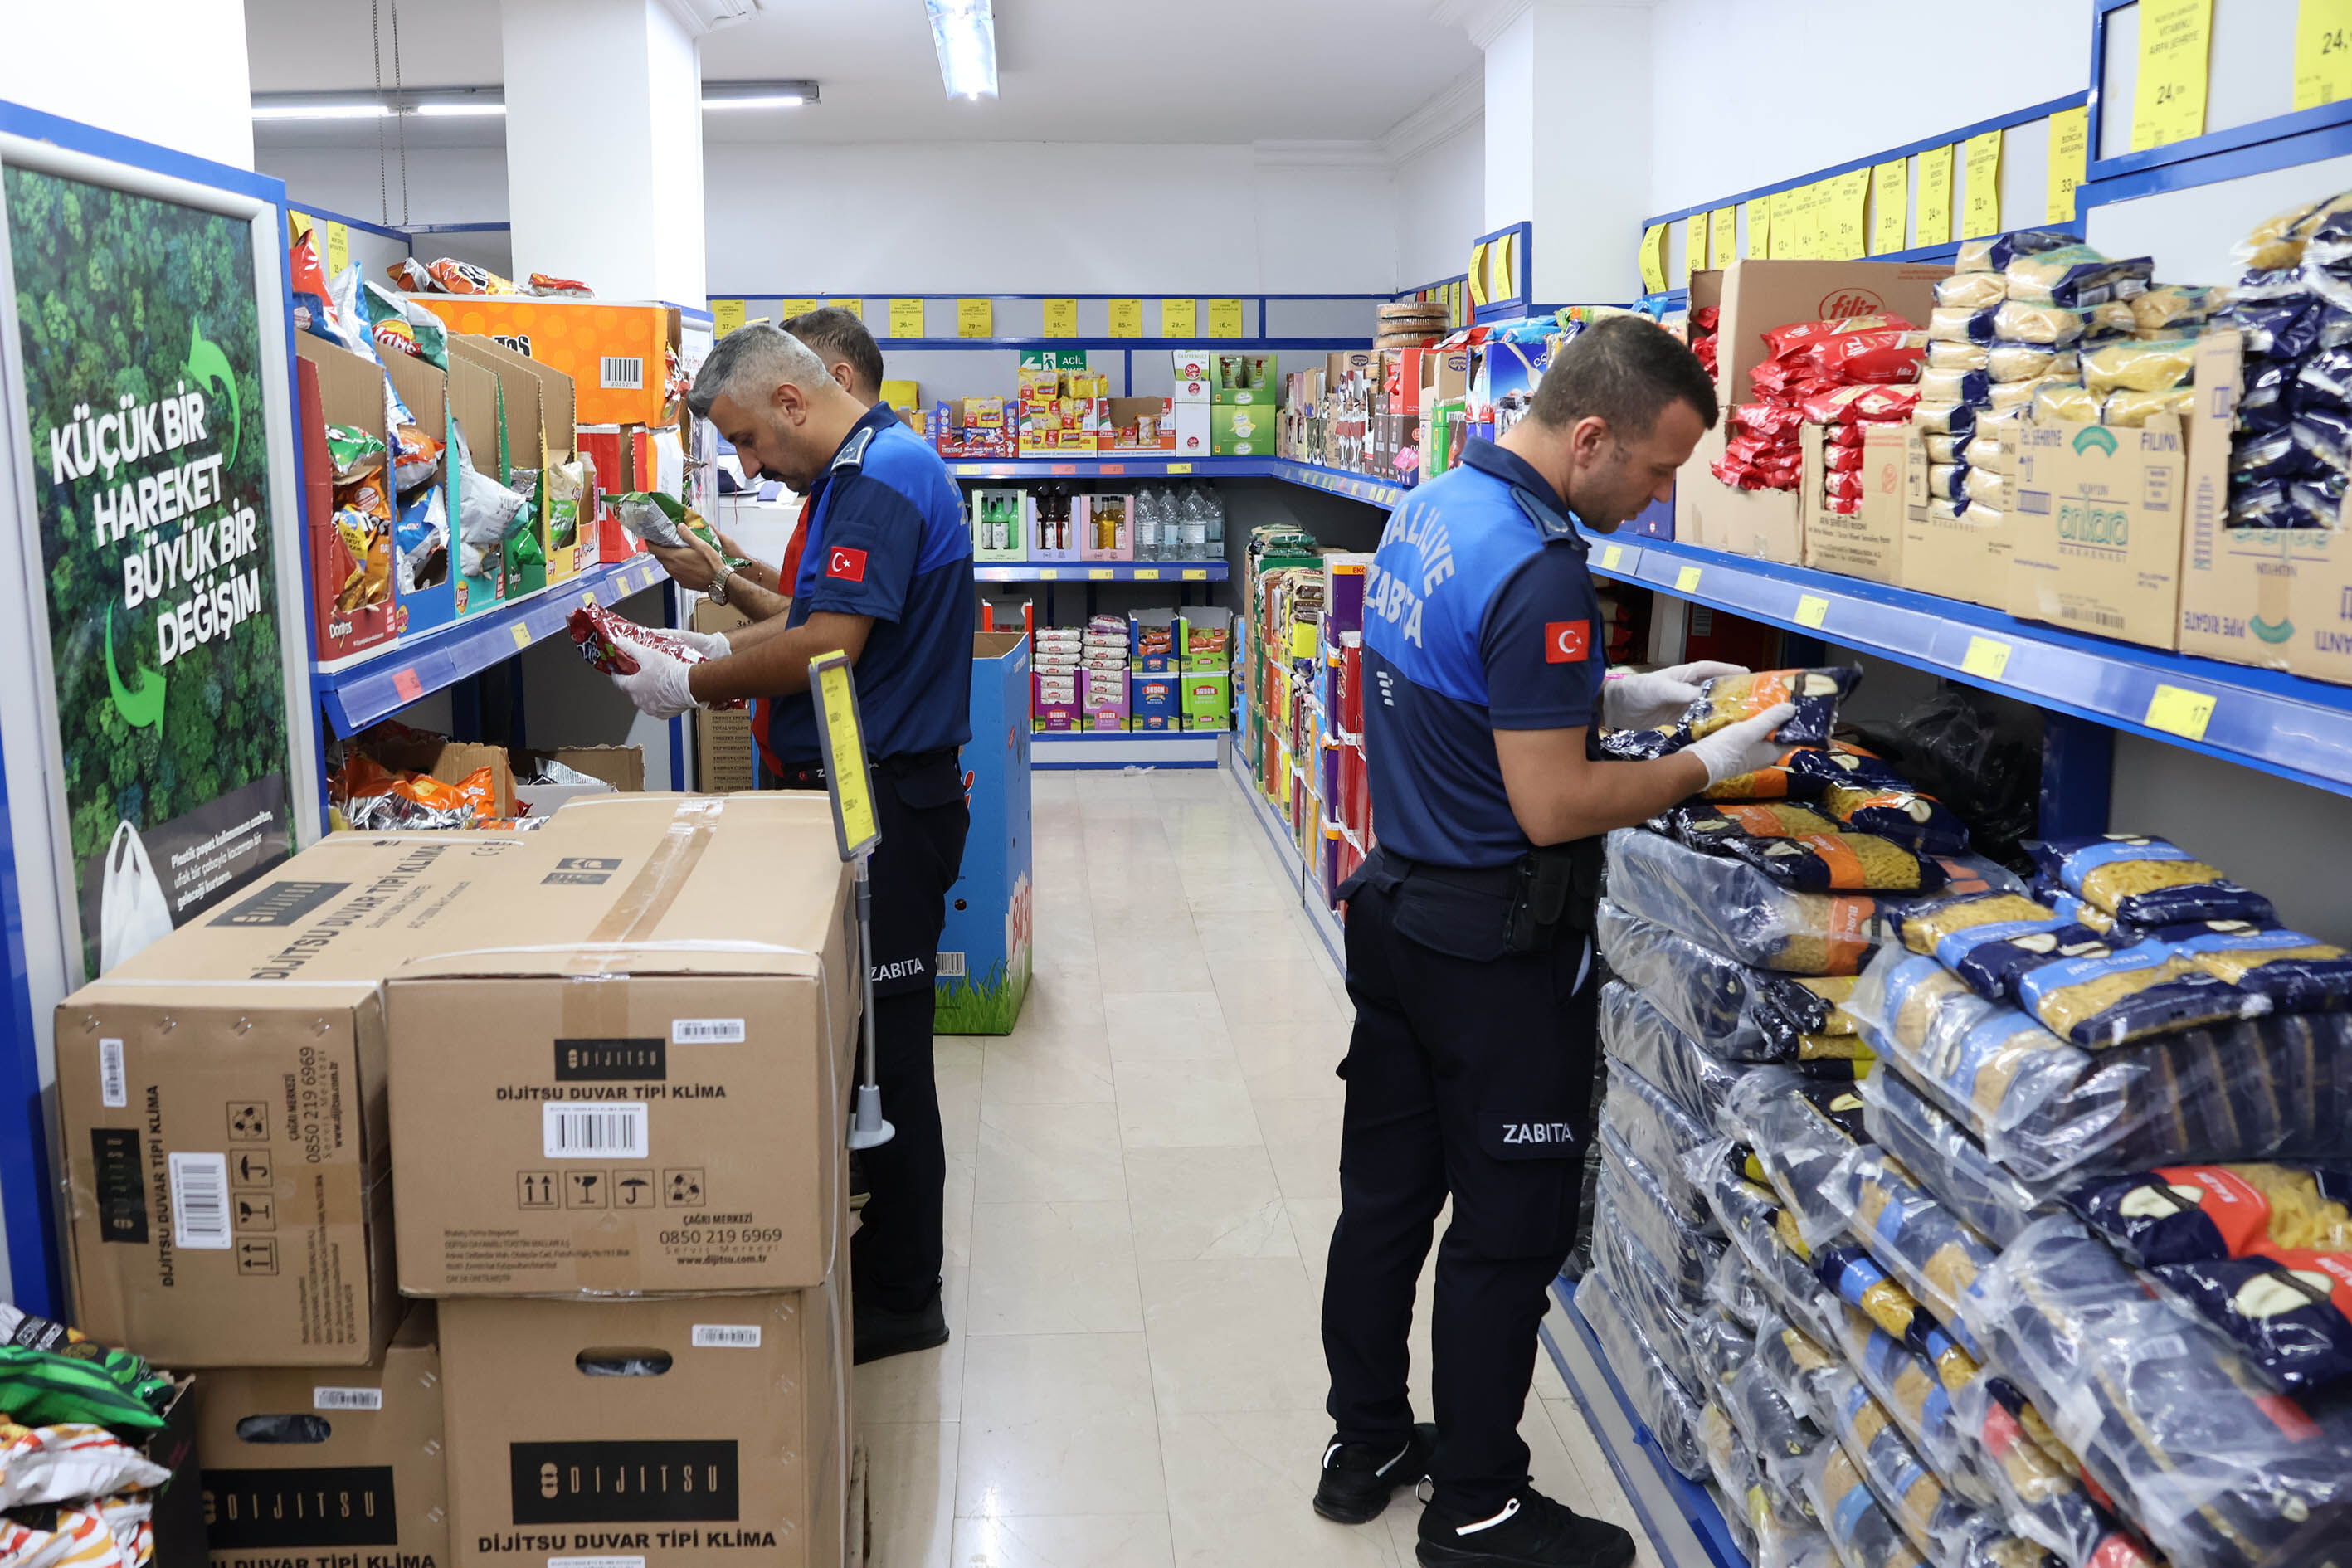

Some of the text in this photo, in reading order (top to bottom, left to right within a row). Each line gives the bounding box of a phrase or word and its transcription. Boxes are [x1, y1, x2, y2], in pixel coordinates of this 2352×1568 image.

[1062, 355, 1083, 365] ACİL
[51, 380, 207, 485] KÜÇÜK BİR
[93, 453, 223, 548] HAREKET
[2058, 493, 2129, 546] ankara
[124, 498, 257, 610] BÜYÜK BİR
[157, 563, 261, 666] DEĞİŞİM
[1365, 562, 1424, 649] ZABITA
[2184, 611, 2246, 639] PIPE RIGATE
[171, 846, 196, 869] Plastik
[191, 864, 201, 880] bir
[253, 831, 262, 845] bir
[250, 929, 339, 980] DİJİTSU
[317, 895, 391, 927] DUVAR
[392, 845, 450, 873] KLİMA
[871, 957, 924, 981] ZABITA
[299, 1046, 321, 1163] 0850 219 6969
[496, 1083, 726, 1101] DİJİTSU DUVAR TİPİ KLİMA
[1502, 1122, 1574, 1144] ZABITA
[145, 1085, 174, 1287] DİJİTSU DUVAR TİPİ KLİMA
[683, 1212, 753, 1226] ÇAĞRI MERKEZİ
[660, 1228, 782, 1244] 0850 219 6969
[665, 1246, 711, 1255] Servis
[677, 1255, 767, 1266] www.dijitsu.com.tr
[570, 1464, 718, 1494] DIJITSU
[227, 1491, 374, 1520] DIJITSU
[478, 1528, 776, 1552] DİJİTSU DUVAR TİPİ KLİMA
[235, 1552, 436, 1568] DUVAR TİPİ KLİMA
